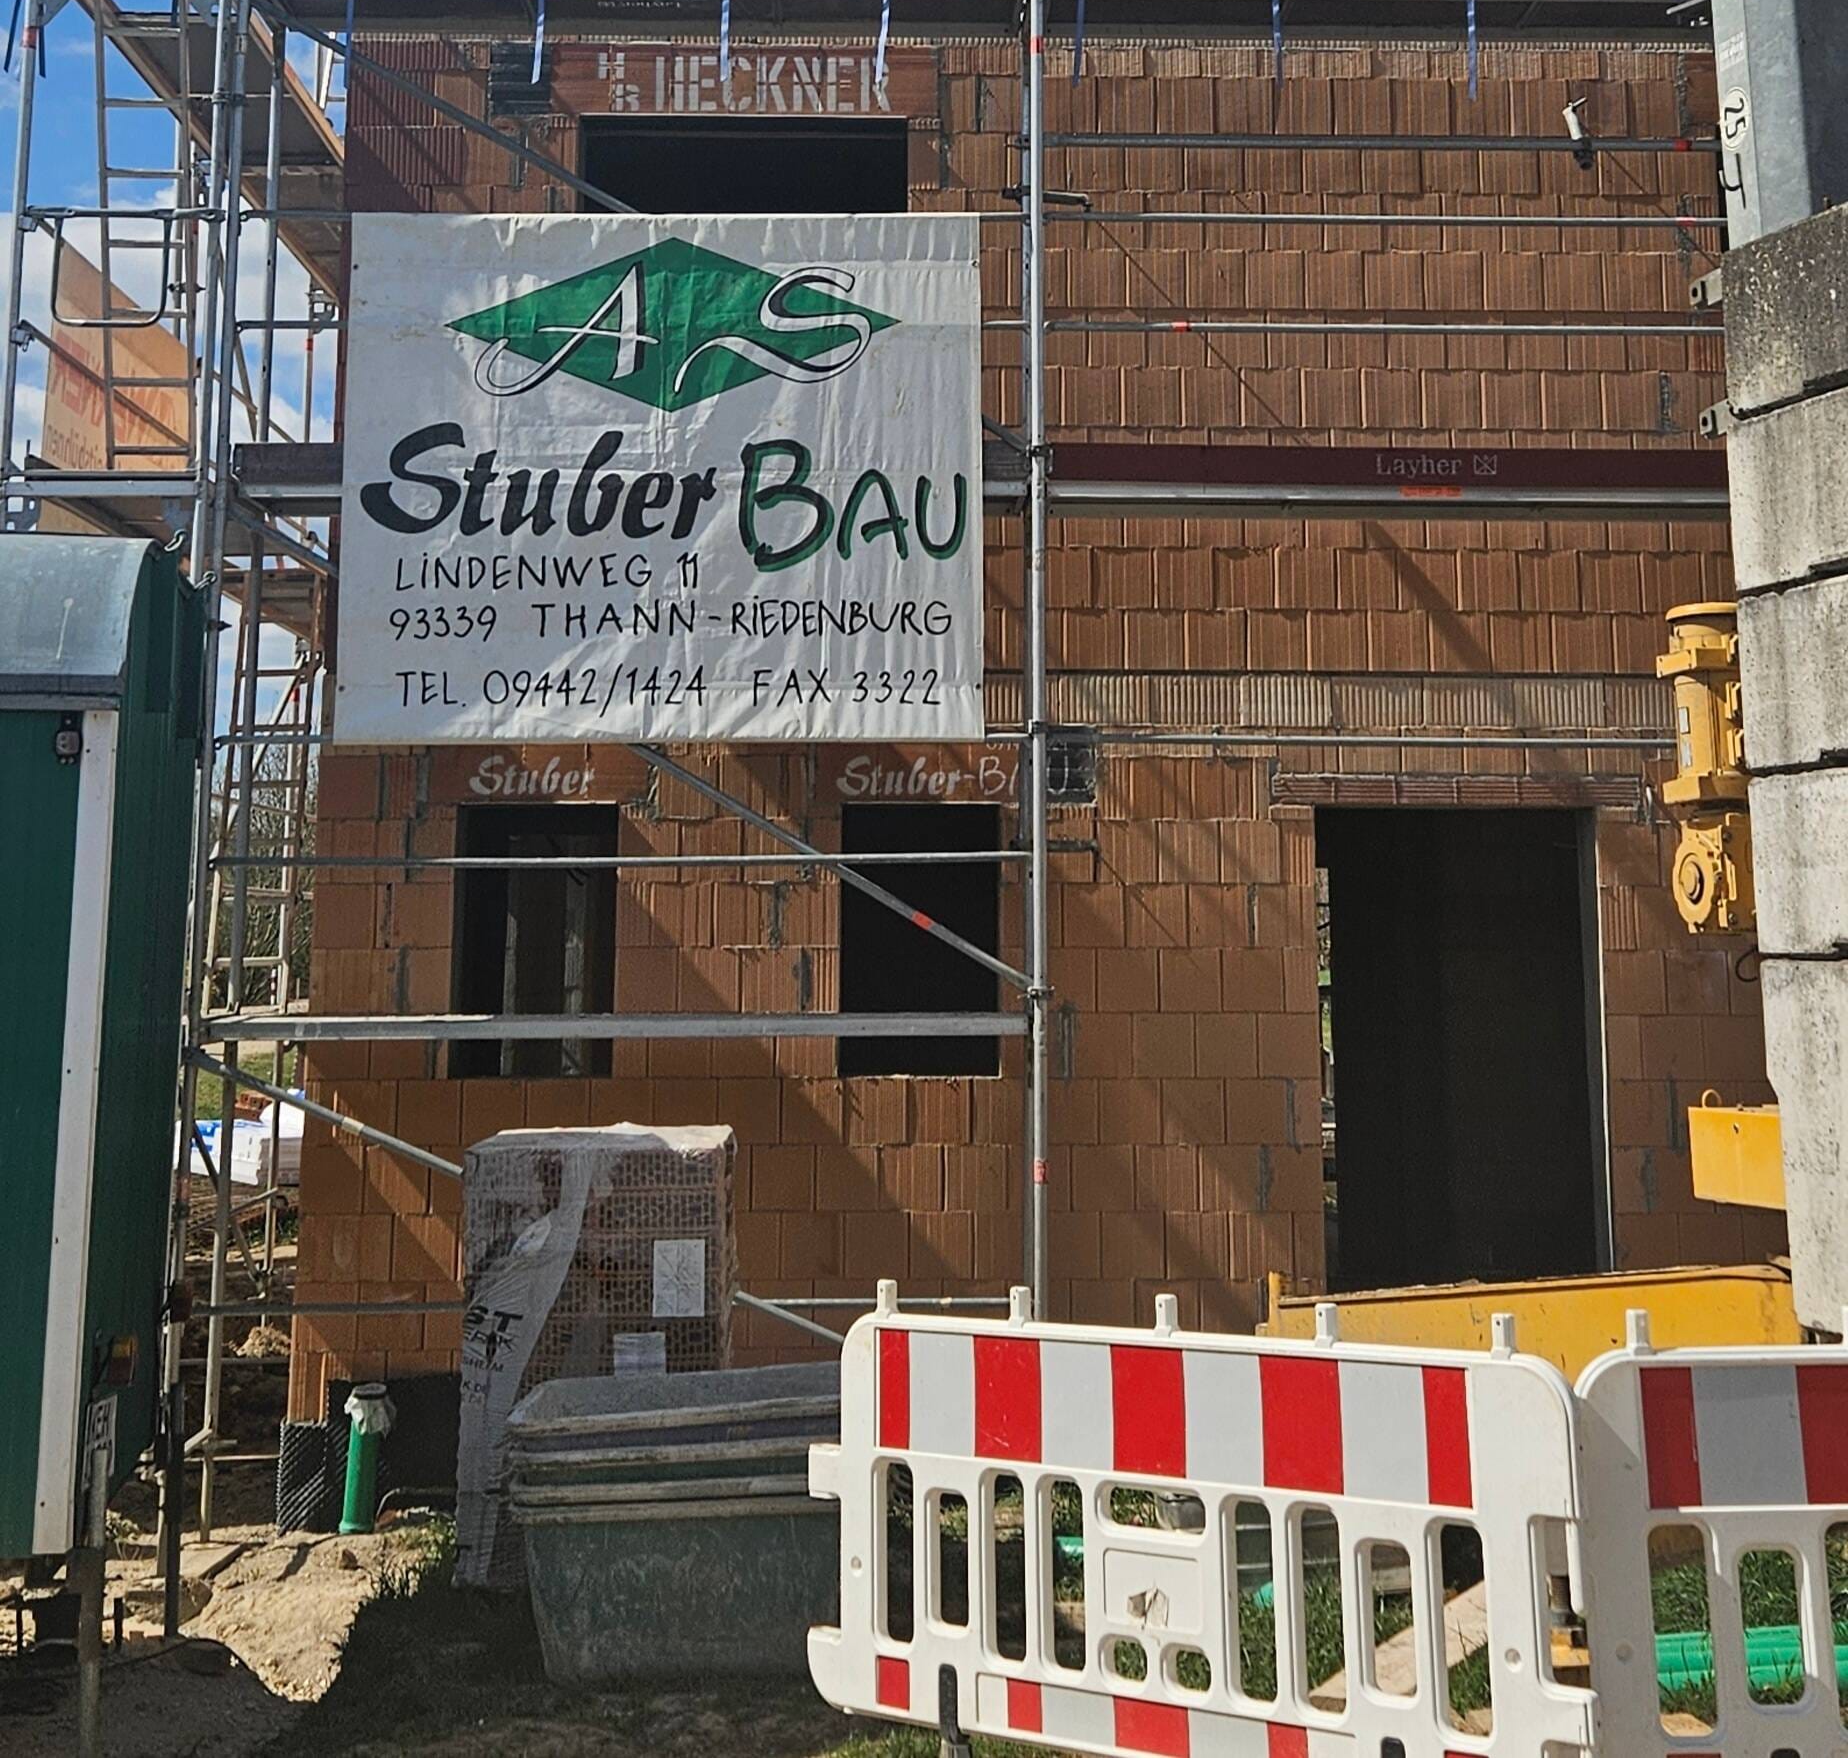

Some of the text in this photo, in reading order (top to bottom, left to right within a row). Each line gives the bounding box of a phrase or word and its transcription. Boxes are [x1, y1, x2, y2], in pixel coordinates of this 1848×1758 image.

[1376, 453, 1462, 479] Layher
[360, 422, 969, 573] Stuber BAU
[395, 552, 699, 592] LINDENWEG 11
[388, 602, 498, 641] 93339
[395, 664, 942, 718] TEL. 09442/1424 FAX 3322
[469, 754, 596, 798] Stuber
